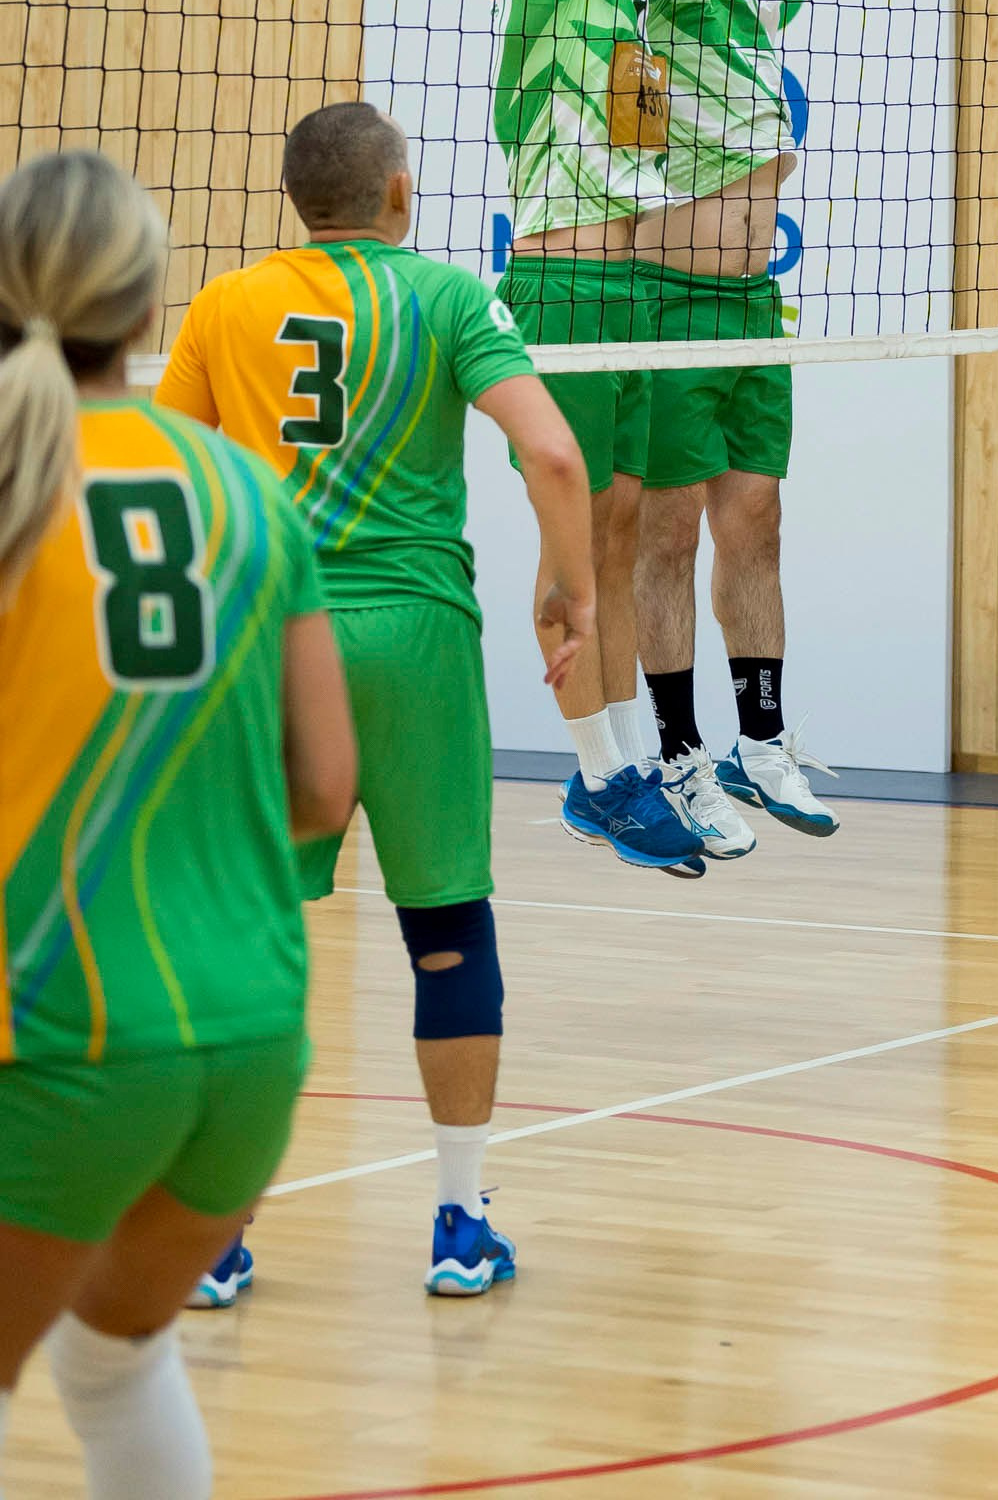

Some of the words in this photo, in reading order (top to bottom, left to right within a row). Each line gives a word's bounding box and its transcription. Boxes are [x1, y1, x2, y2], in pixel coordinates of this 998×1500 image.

[276, 311, 349, 448] 3
[80, 467, 214, 691] 8
[760, 668, 773, 698] FORTIS
